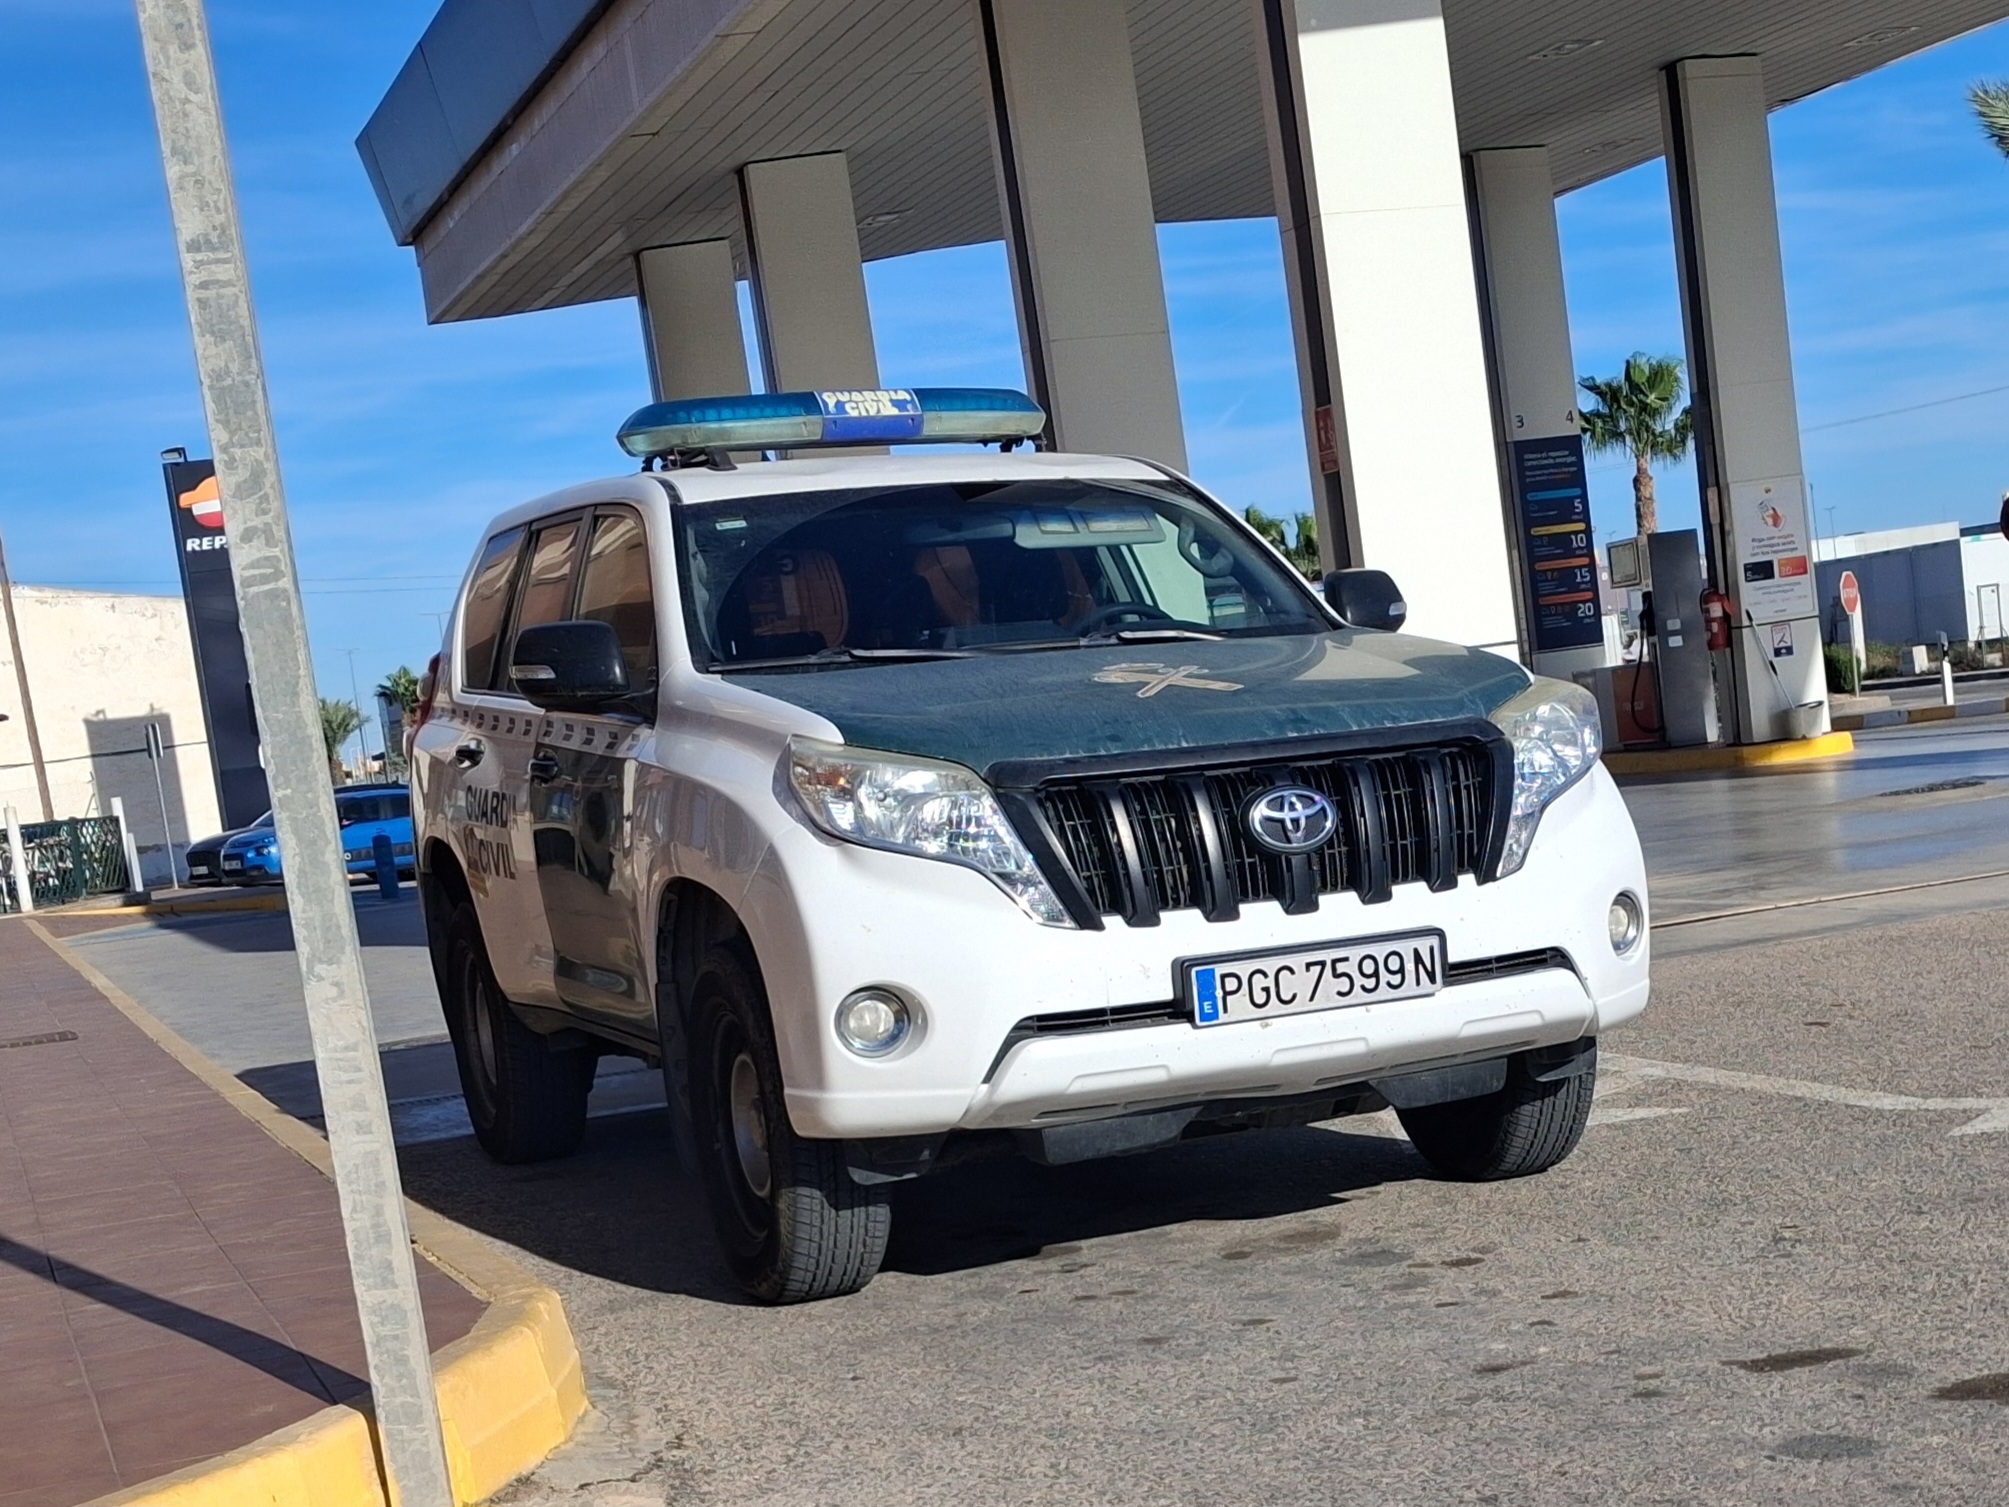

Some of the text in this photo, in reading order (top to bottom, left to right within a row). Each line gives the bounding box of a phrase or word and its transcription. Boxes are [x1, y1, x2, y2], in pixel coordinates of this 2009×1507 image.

[844, 401, 899, 416] CIVIL
[1514, 414, 1525, 429] 3
[1565, 410, 1575, 425] 4
[1573, 498, 1583, 513] 5
[186, 535, 228, 552] REP
[1570, 533, 1587, 548] 10
[1574, 567, 1591, 583] 15
[1577, 602, 1595, 617] 20
[479, 838, 517, 880] CIVIL
[1203, 1001, 1214, 1014] E
